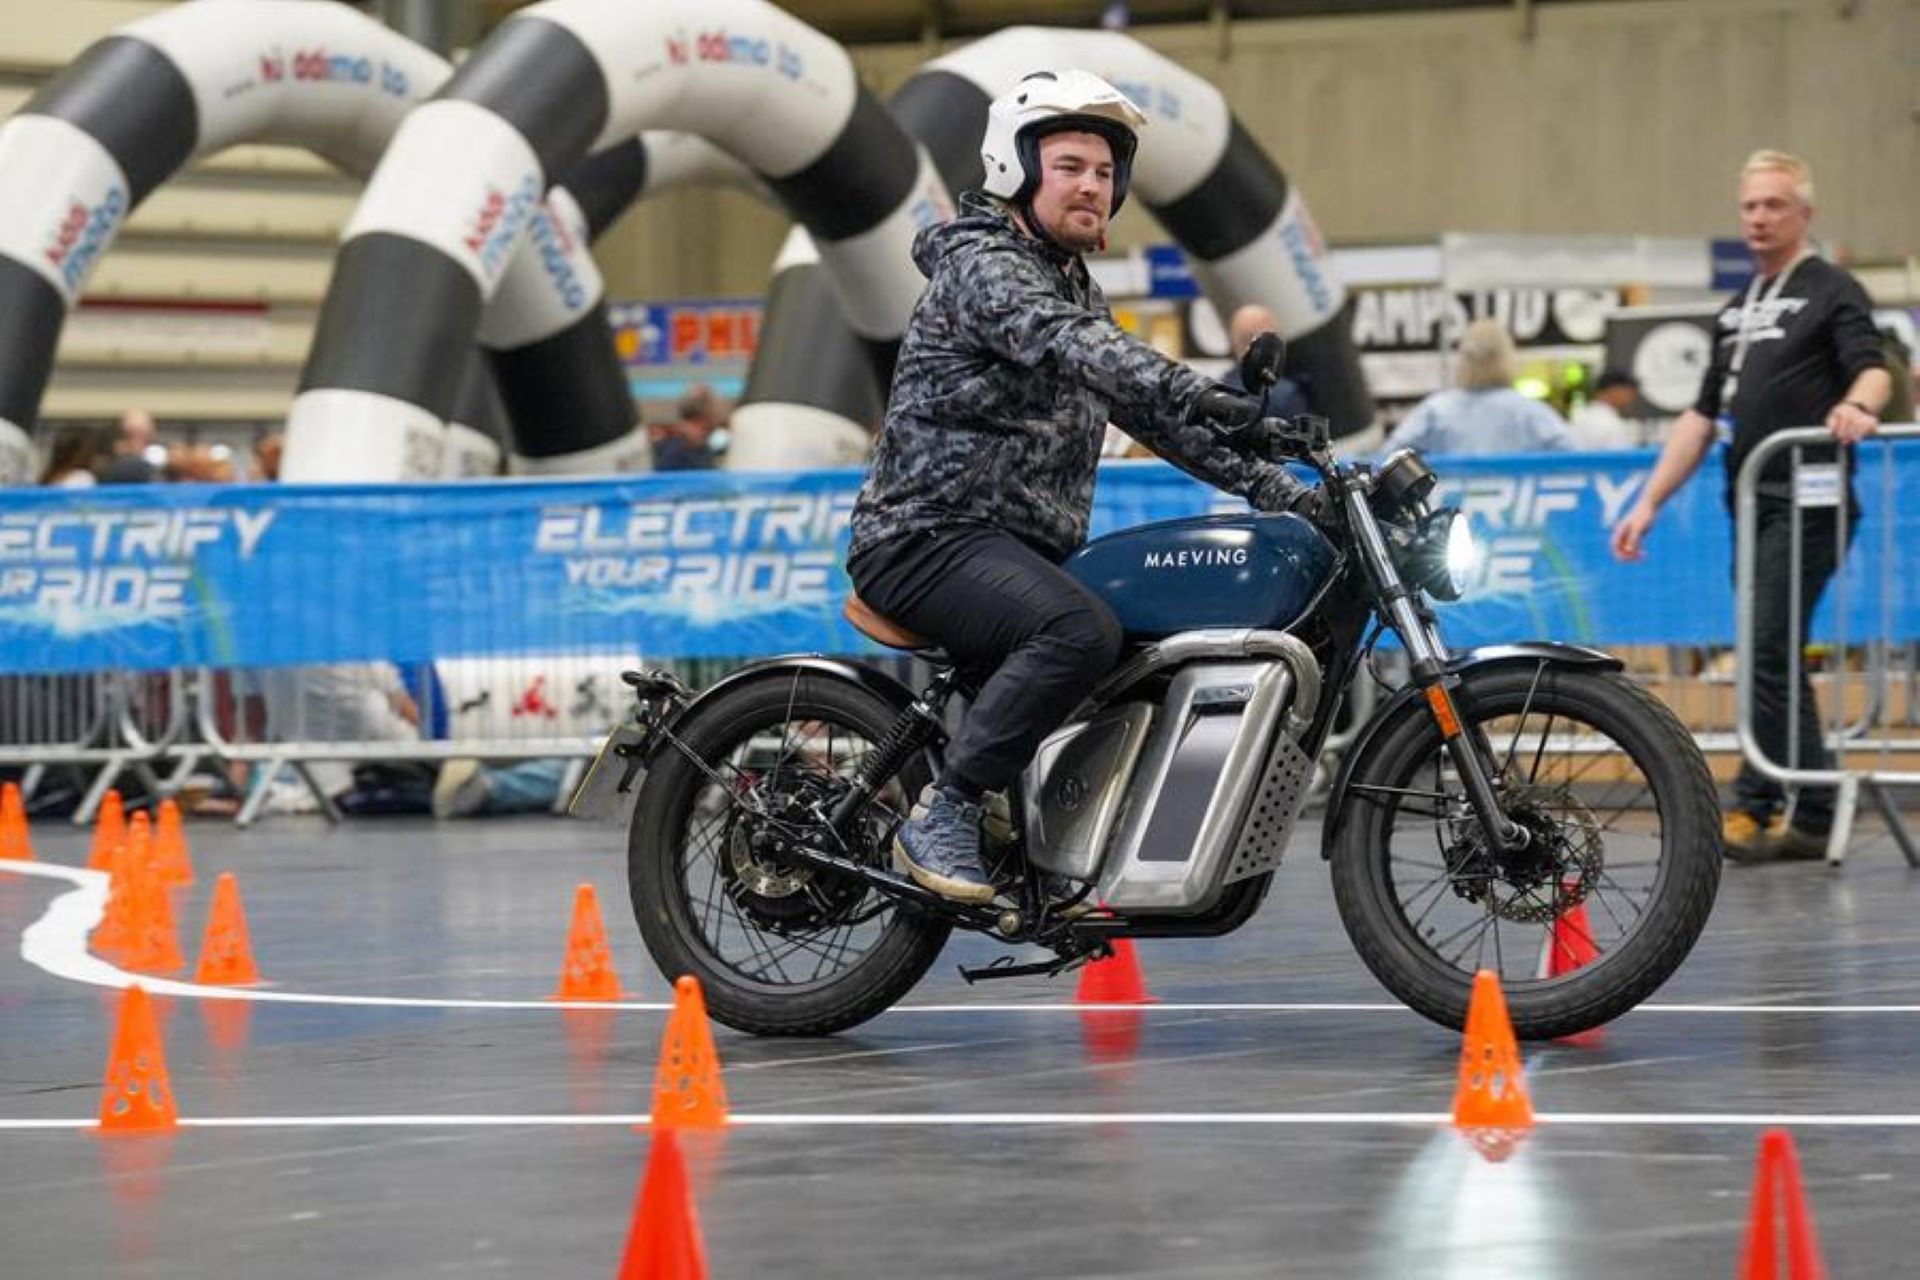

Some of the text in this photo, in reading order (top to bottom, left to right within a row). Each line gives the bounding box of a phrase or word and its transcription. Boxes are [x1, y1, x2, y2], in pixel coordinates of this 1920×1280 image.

[565, 554, 834, 600] YOUR RIDE
[1144, 548, 1248, 568] MAEVING
[37, 565, 191, 612] RIDE
